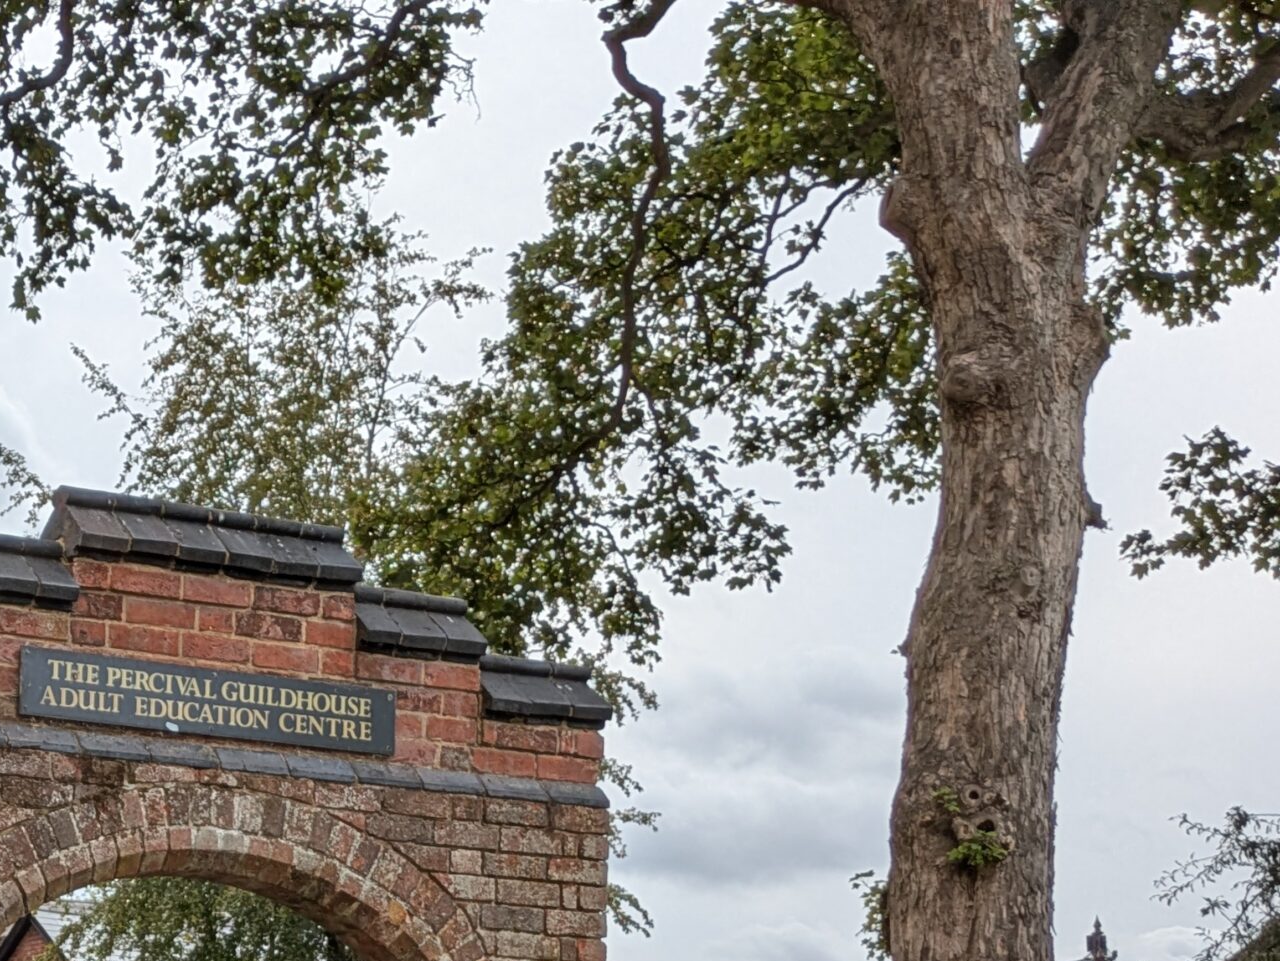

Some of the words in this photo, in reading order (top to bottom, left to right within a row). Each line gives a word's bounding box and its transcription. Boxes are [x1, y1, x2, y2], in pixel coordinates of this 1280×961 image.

[40, 685, 124, 713] ADULT
[135, 696, 269, 729] EDUCATION
[278, 712, 372, 741] CENTRE
[47, 659, 100, 685] THE
[106, 666, 217, 699] PERCIVAL
[221, 681, 372, 718] GUILDHOUSE
